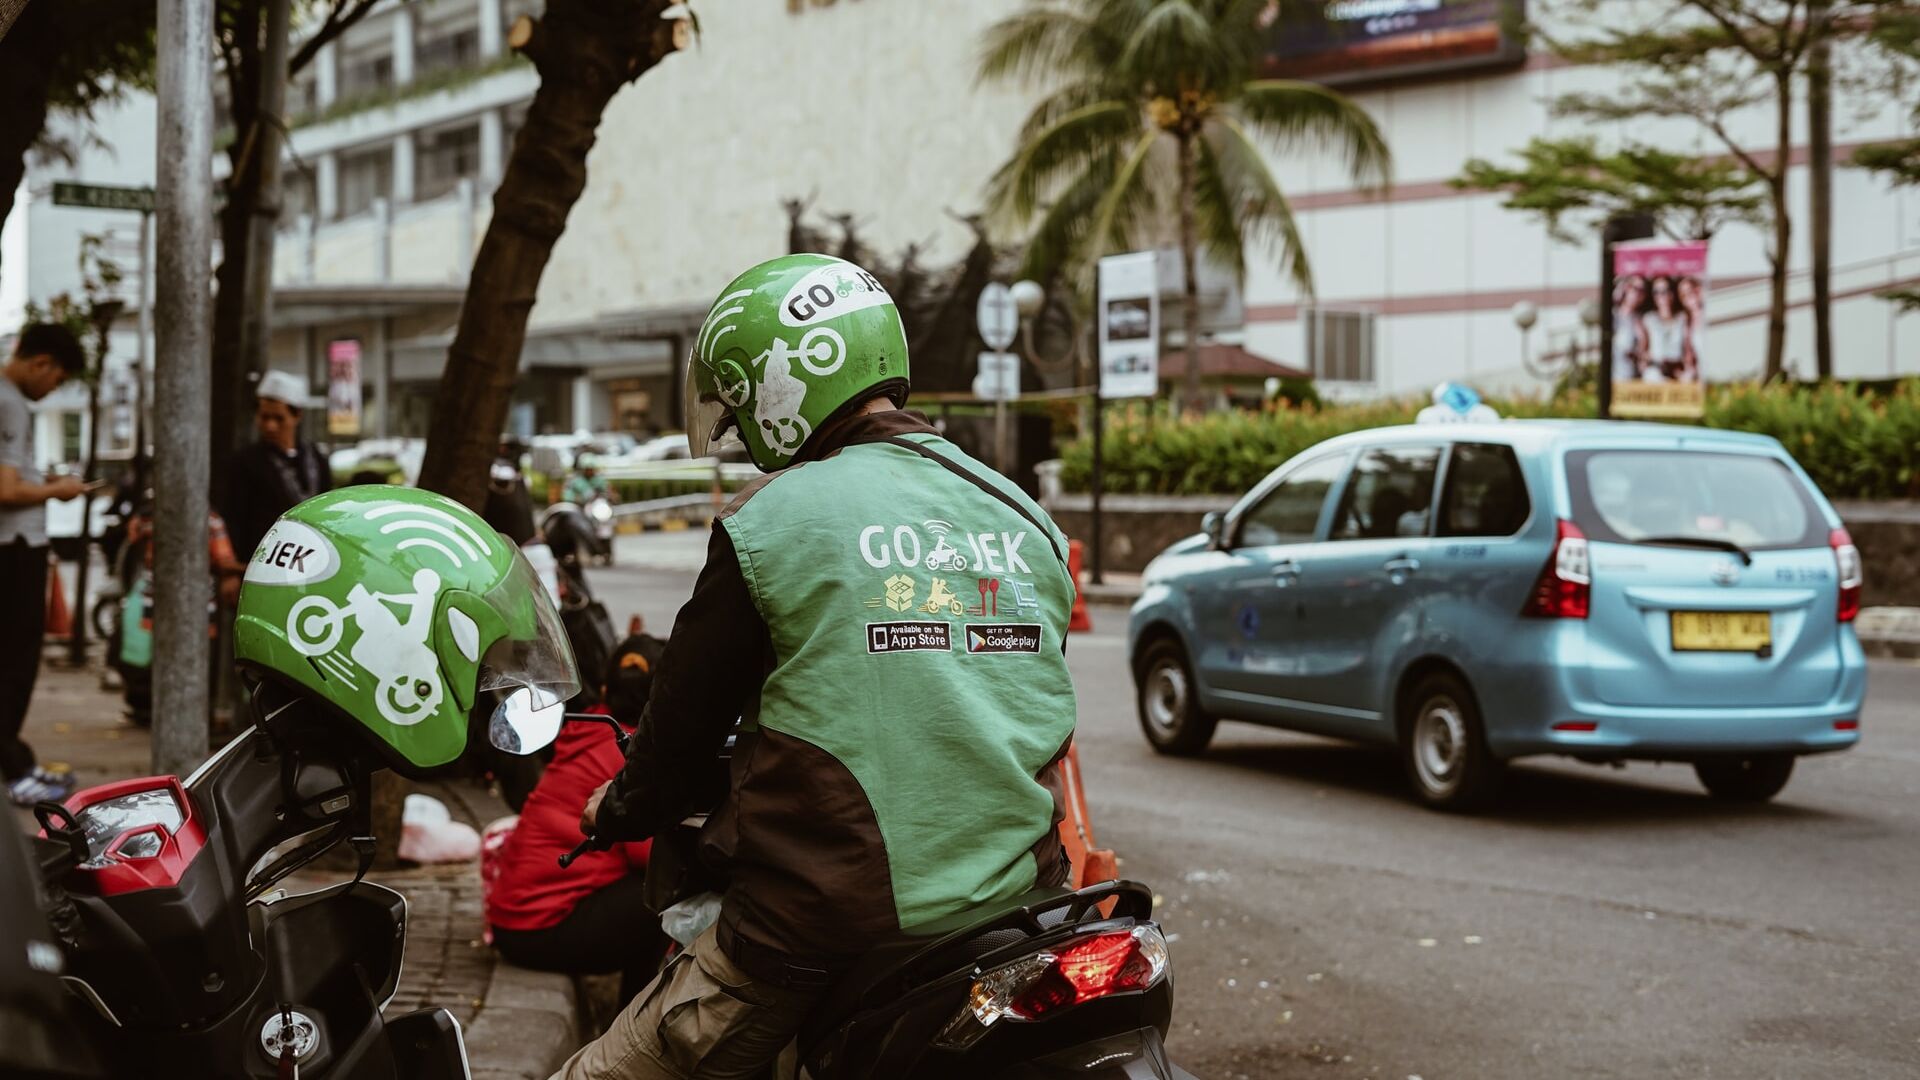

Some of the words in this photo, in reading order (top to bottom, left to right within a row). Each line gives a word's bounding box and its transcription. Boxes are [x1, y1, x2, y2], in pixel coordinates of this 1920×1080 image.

[788, 284, 835, 321] GO
[265, 540, 316, 573] JEK
[859, 525, 921, 568] GO
[967, 531, 1033, 574] JEK
[890, 625, 921, 634] Available
[891, 635, 917, 648] App
[919, 634, 946, 645] Store
[987, 635, 1019, 649] Google
[1019, 636, 1037, 648] play
